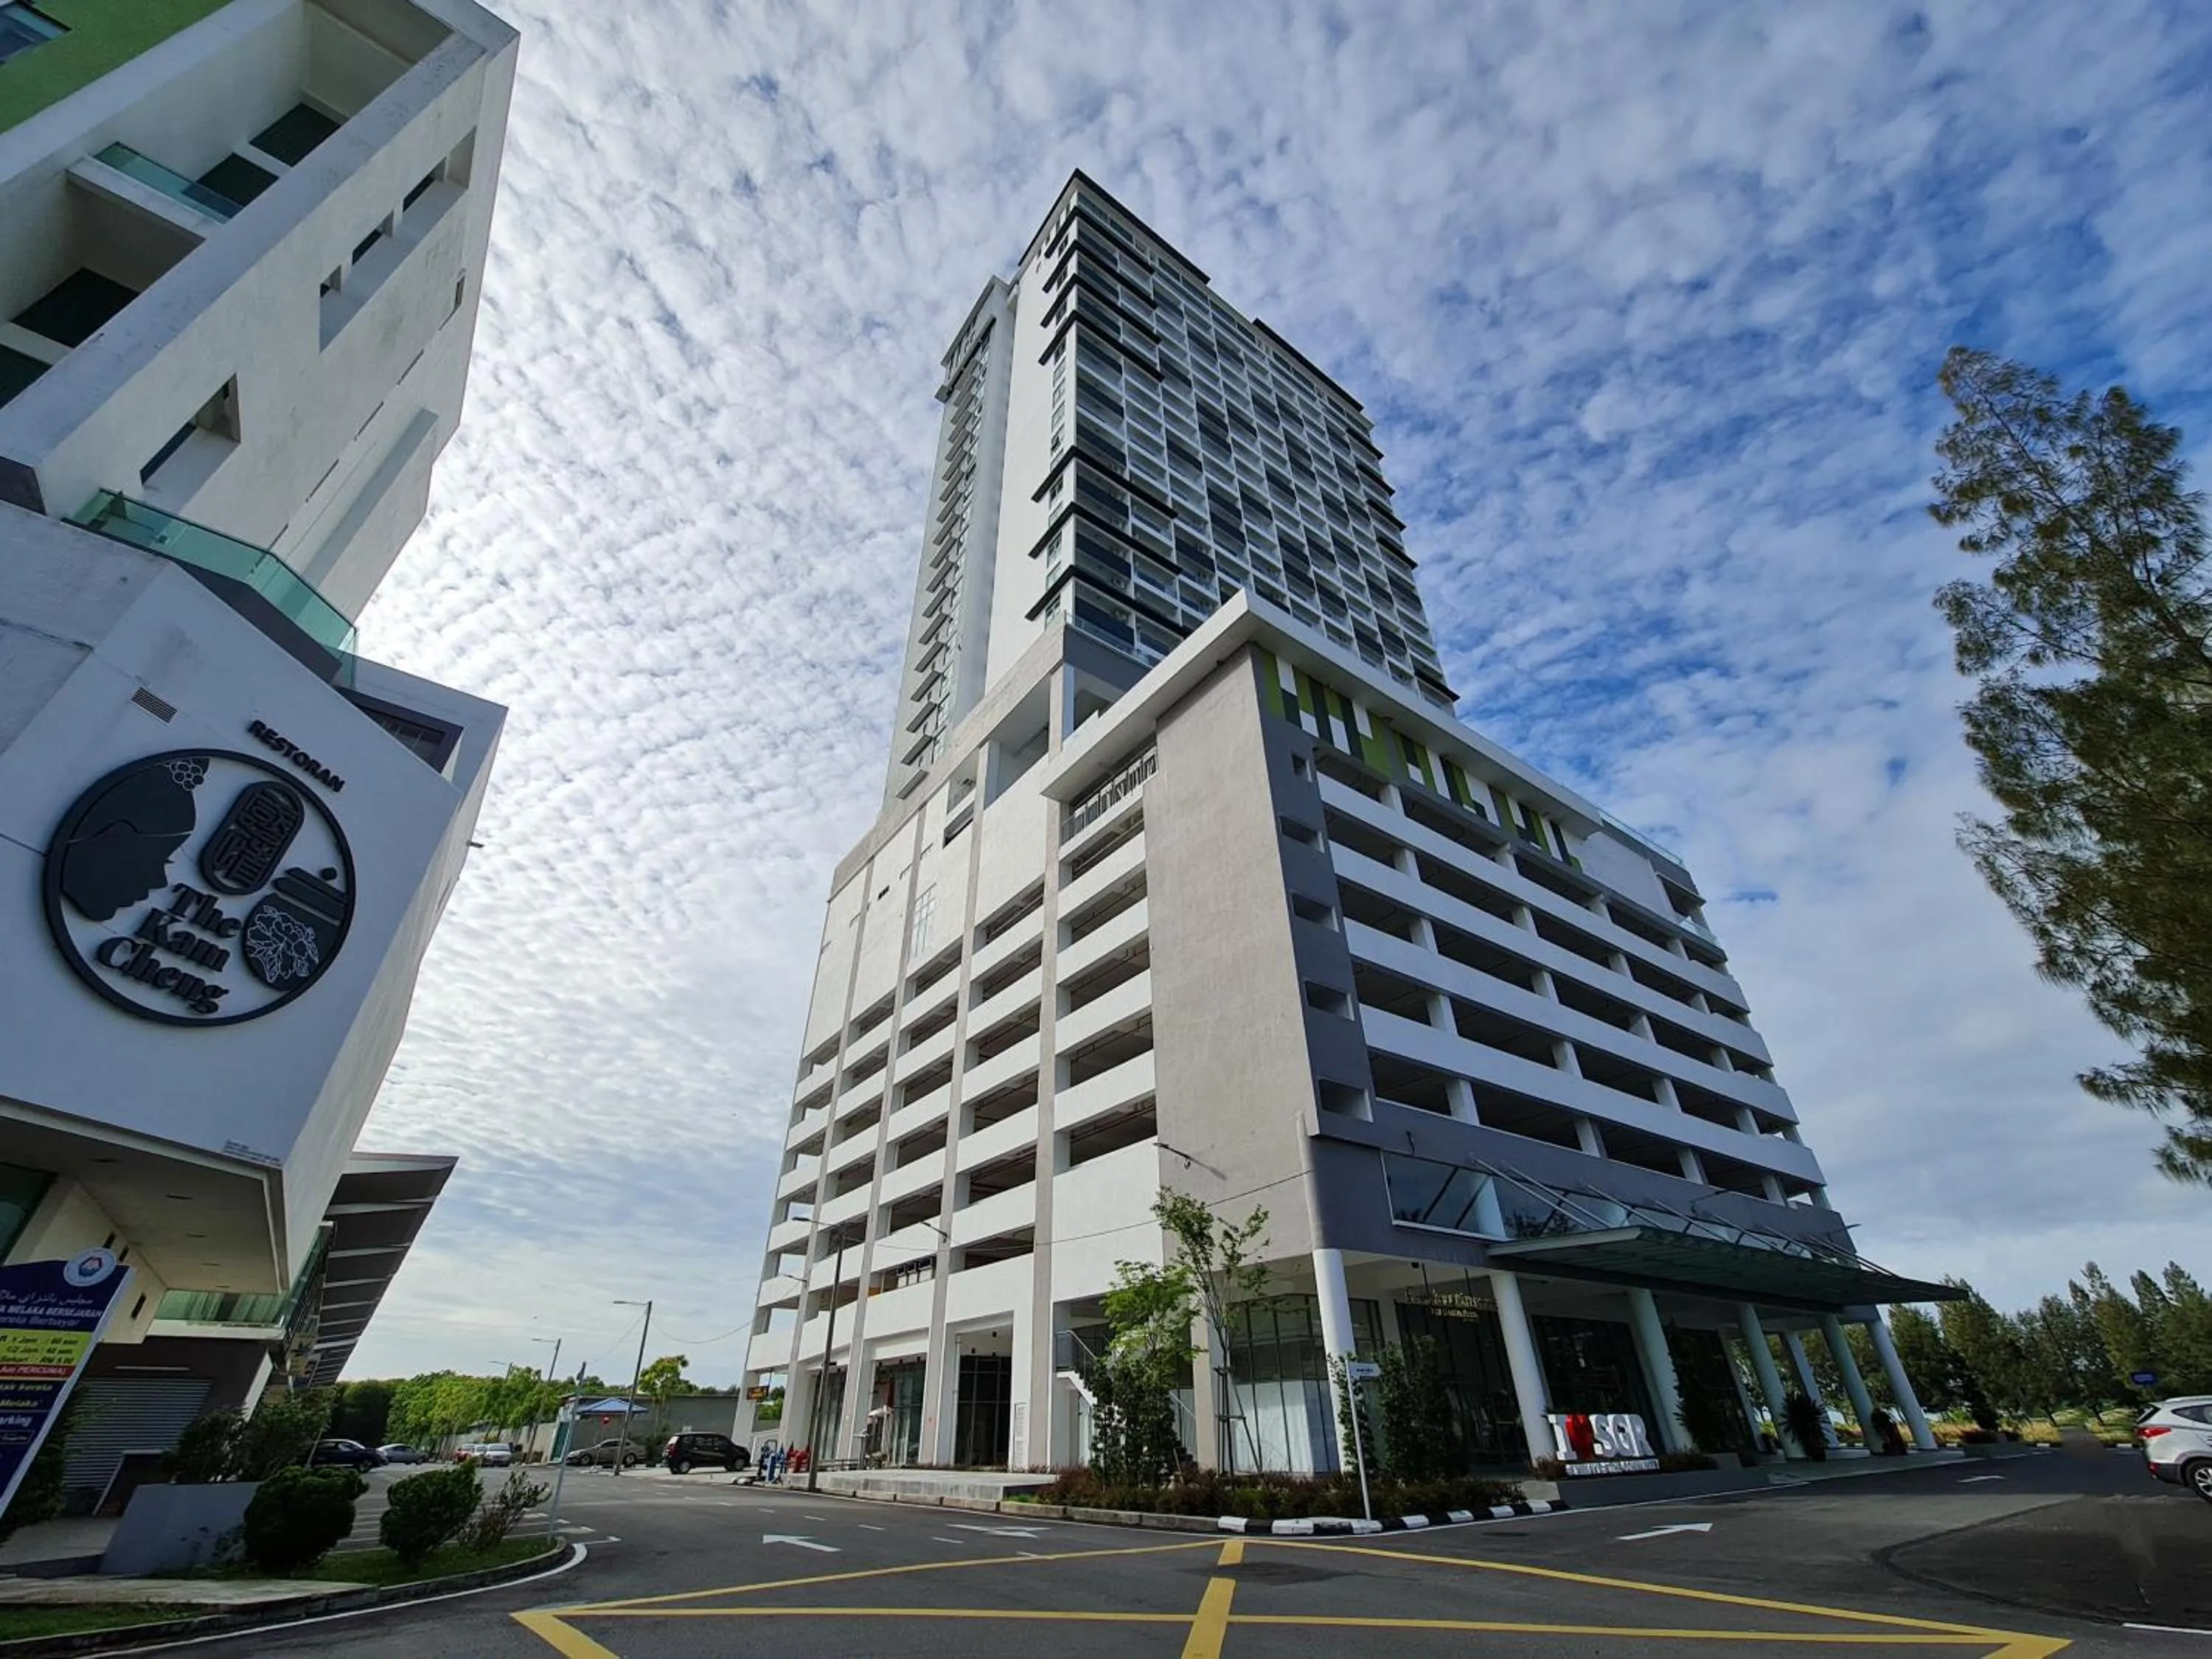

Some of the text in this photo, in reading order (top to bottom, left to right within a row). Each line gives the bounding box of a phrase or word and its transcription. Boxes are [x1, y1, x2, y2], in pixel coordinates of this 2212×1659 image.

[248, 720, 345, 792] RESTORAN
[135, 908, 231, 972] Kam
[168, 883, 242, 937] The
[98, 936, 230, 1014] Cheng
